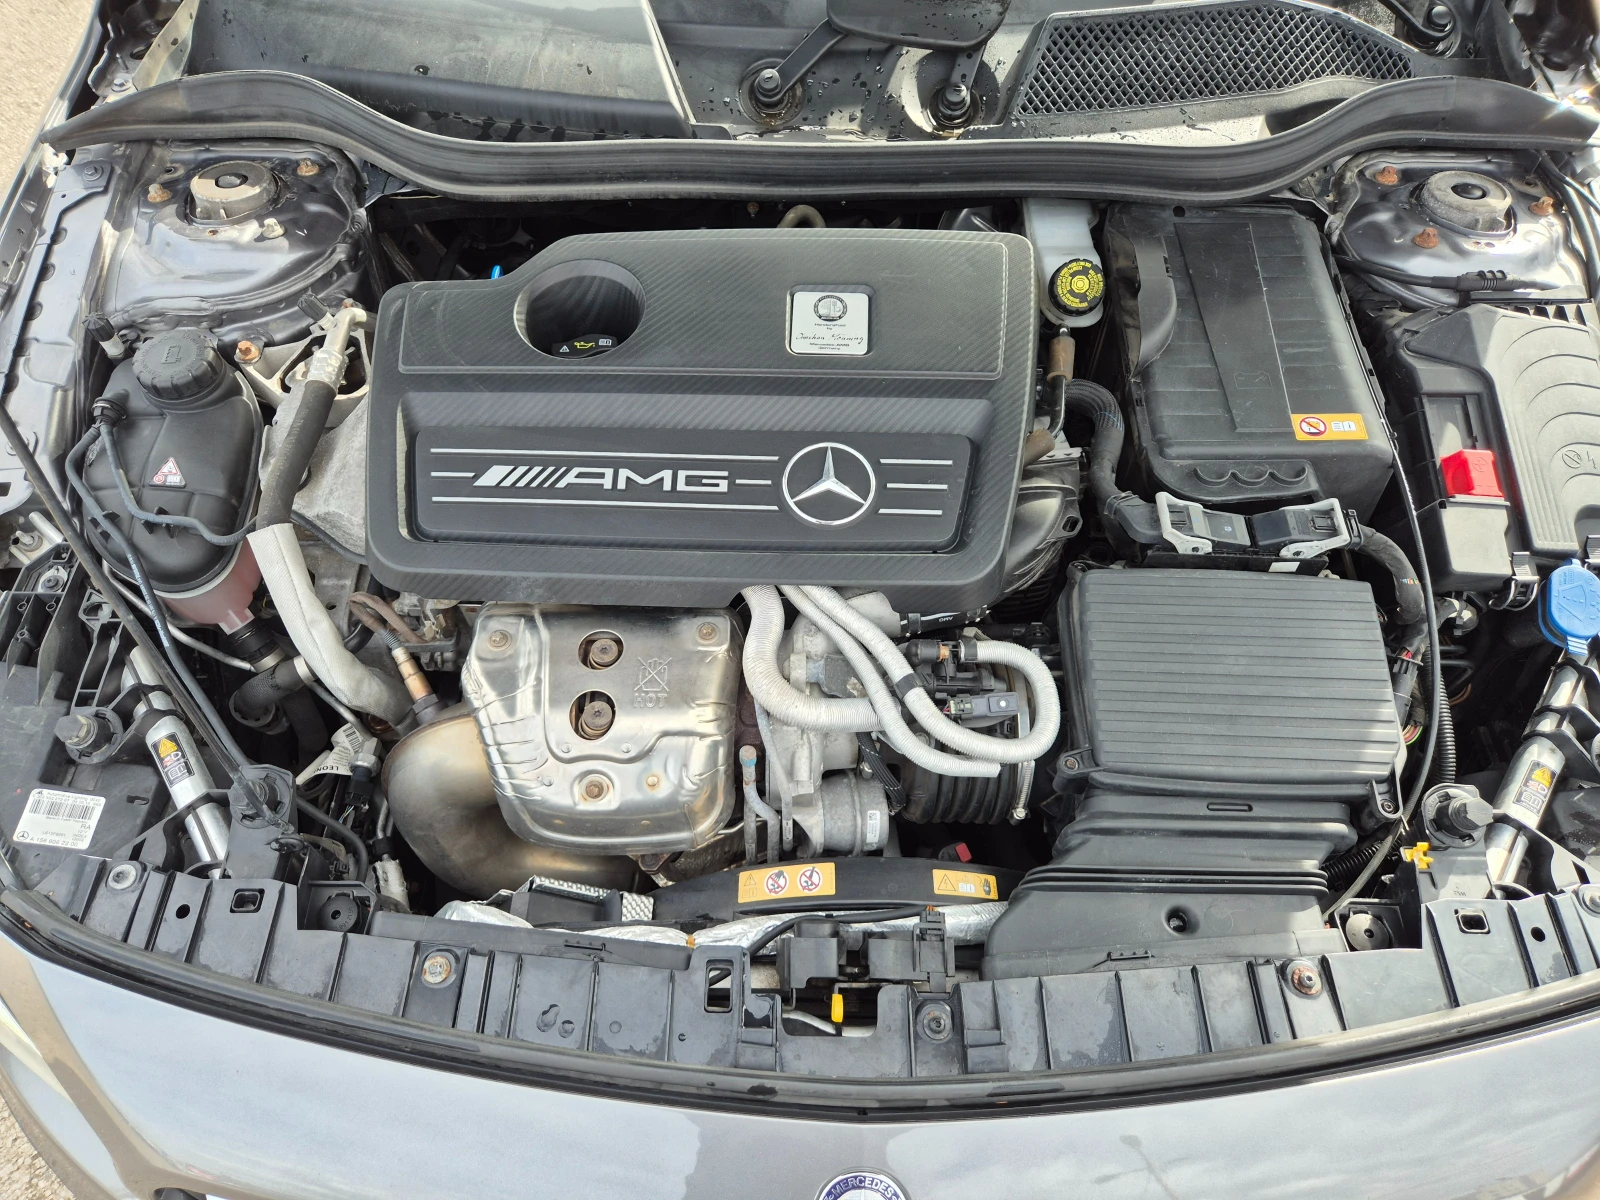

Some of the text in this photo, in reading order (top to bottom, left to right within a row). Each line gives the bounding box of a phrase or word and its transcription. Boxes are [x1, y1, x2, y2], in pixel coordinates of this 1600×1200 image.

[554, 466, 729, 492] AMG
[633, 693, 668, 708] HOT
[831, 1176, 894, 1198] MERCEDES
